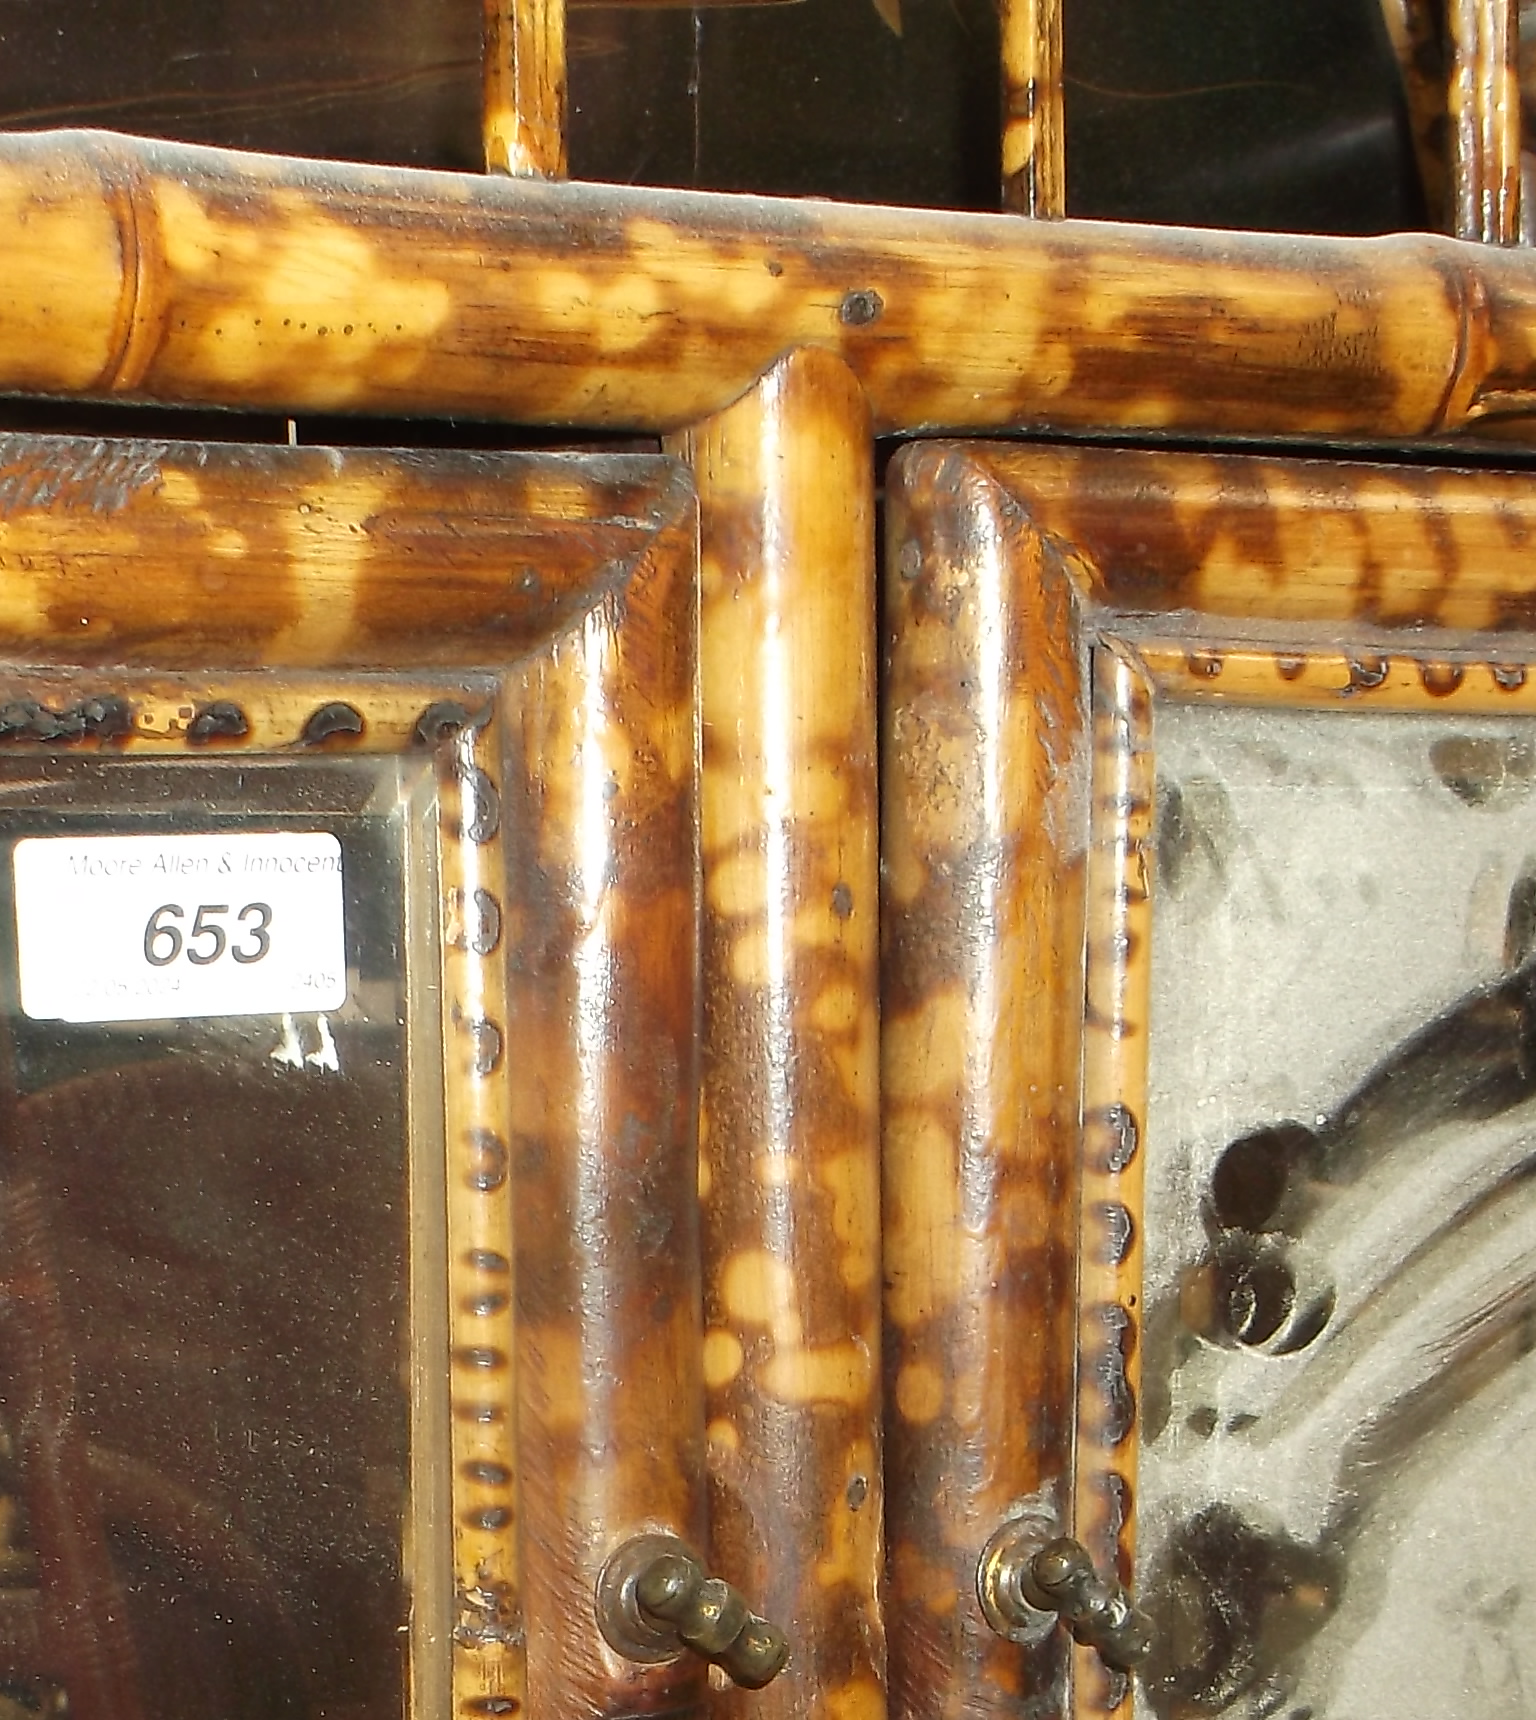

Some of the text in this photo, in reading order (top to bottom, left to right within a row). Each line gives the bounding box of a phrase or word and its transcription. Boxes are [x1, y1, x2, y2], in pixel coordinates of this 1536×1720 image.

[68, 851, 344, 876] Moore Allen & Innocent
[143, 901, 274, 967] 653
